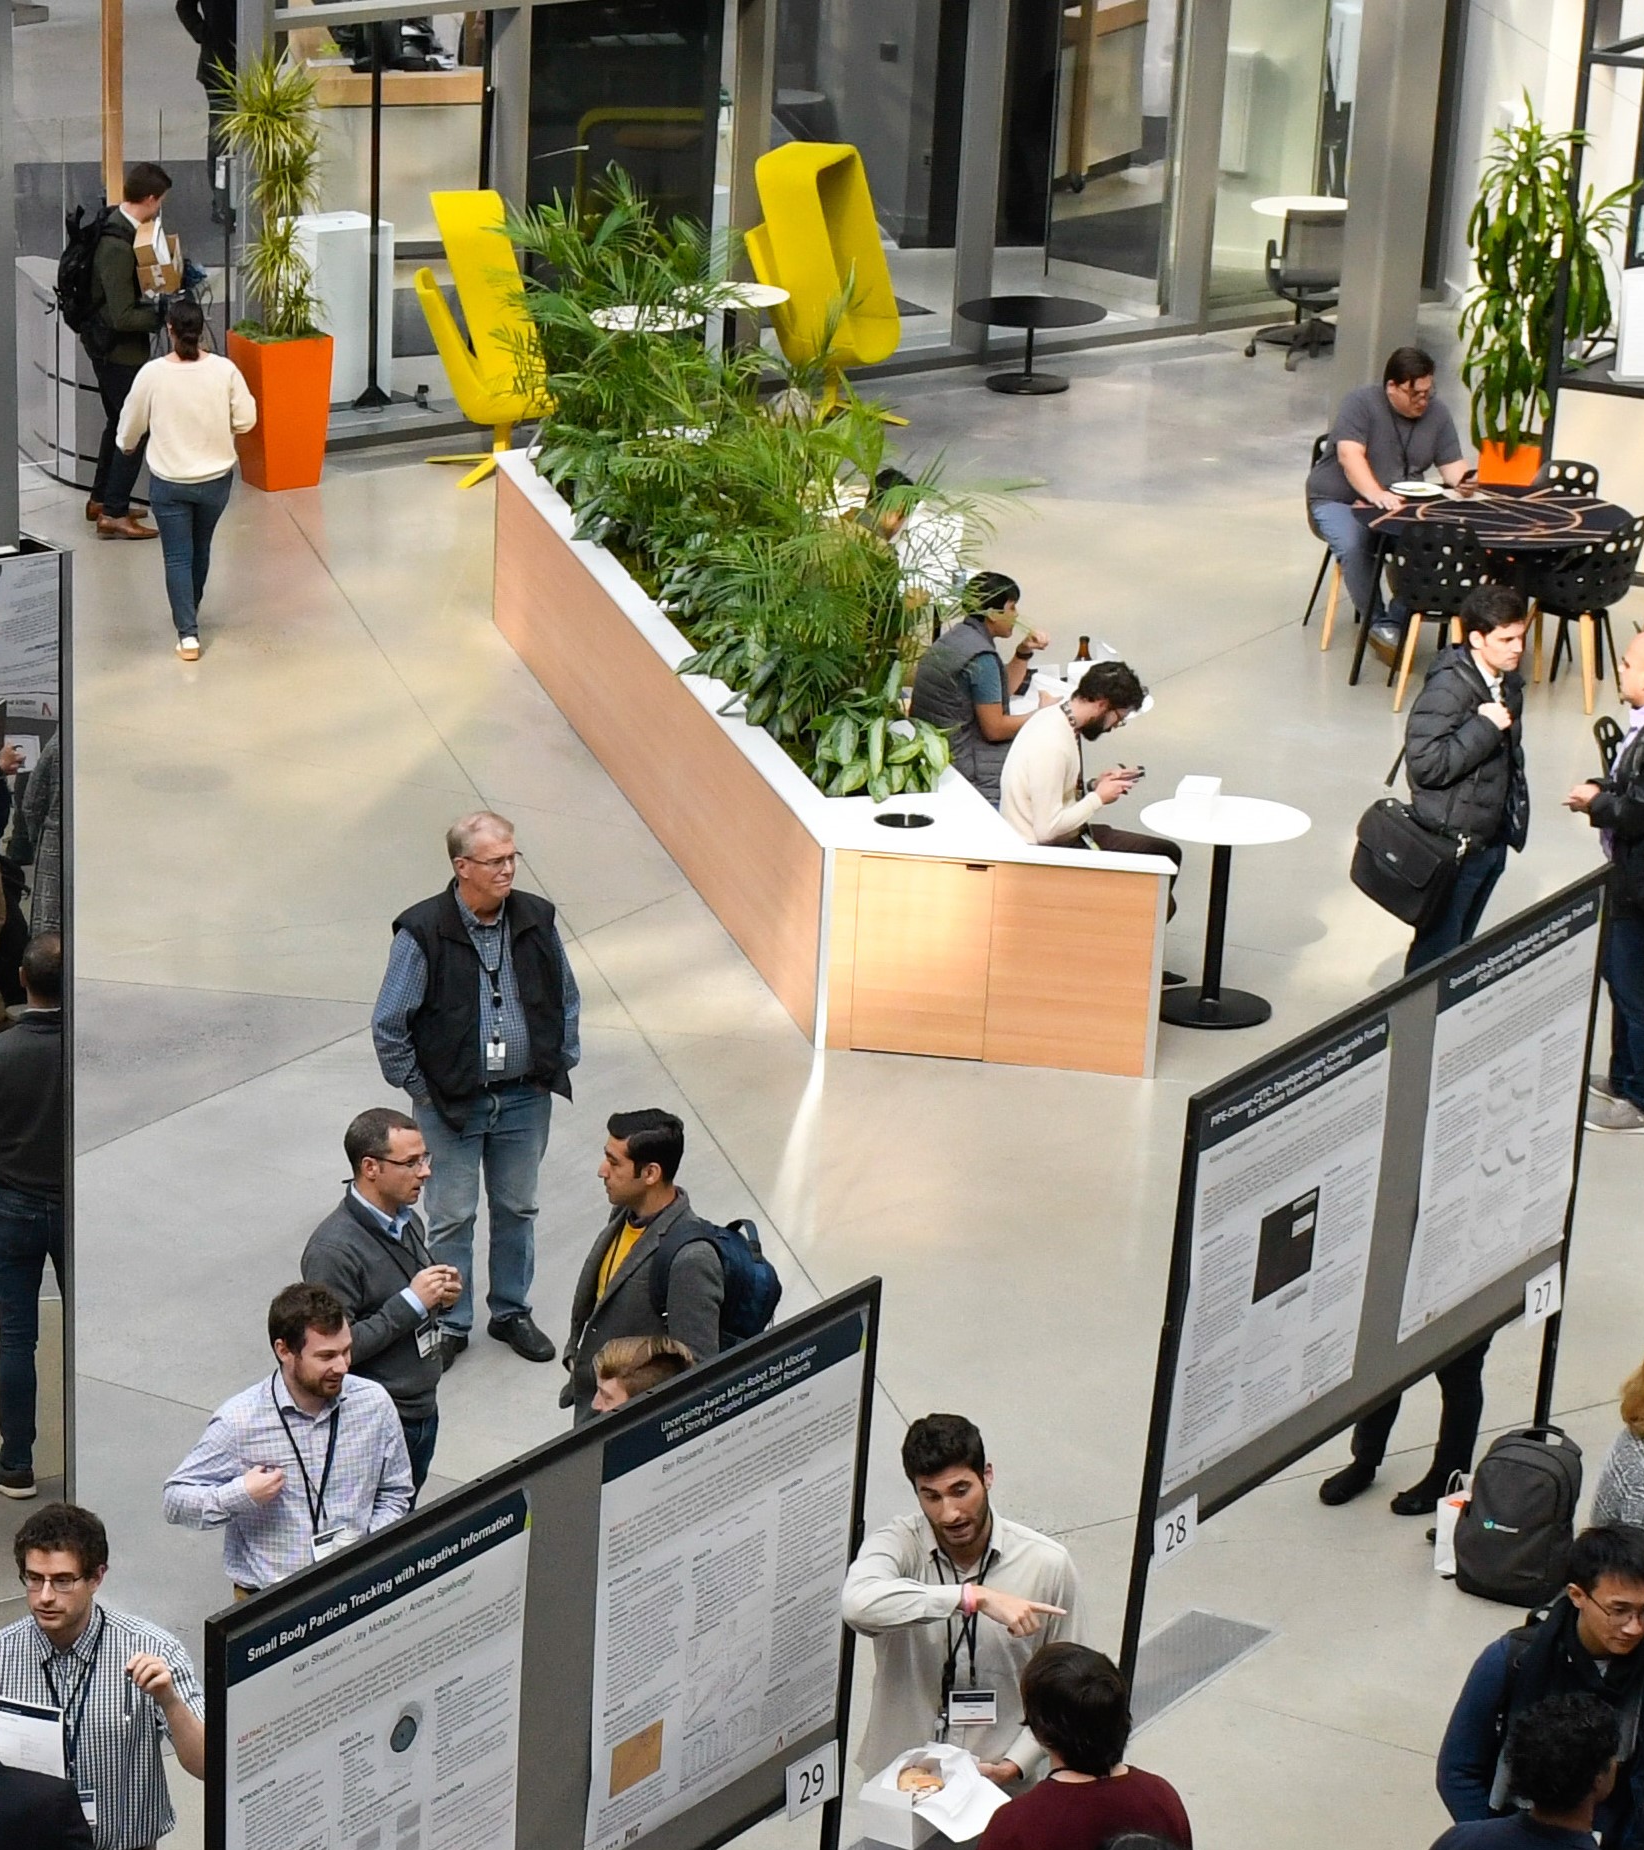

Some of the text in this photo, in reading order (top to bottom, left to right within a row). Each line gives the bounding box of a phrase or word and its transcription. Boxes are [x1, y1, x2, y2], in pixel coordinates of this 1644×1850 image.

[1534, 1280, 1552, 1314] 27
[661, 1339, 816, 1437] Uncertainty-Aware Multi-Robot Task Allocation
[666, 1424, 683, 1444] With
[685, 1408, 713, 1436] Strongly
[715, 1393, 742, 1420] Coupled
[784, 1357, 810, 1383] Rewards
[1166, 1514, 1186, 1552] 28
[247, 1510, 513, 1664] Small Body Particle Tracking with Negative Information
[799, 1763, 824, 1804] 29
